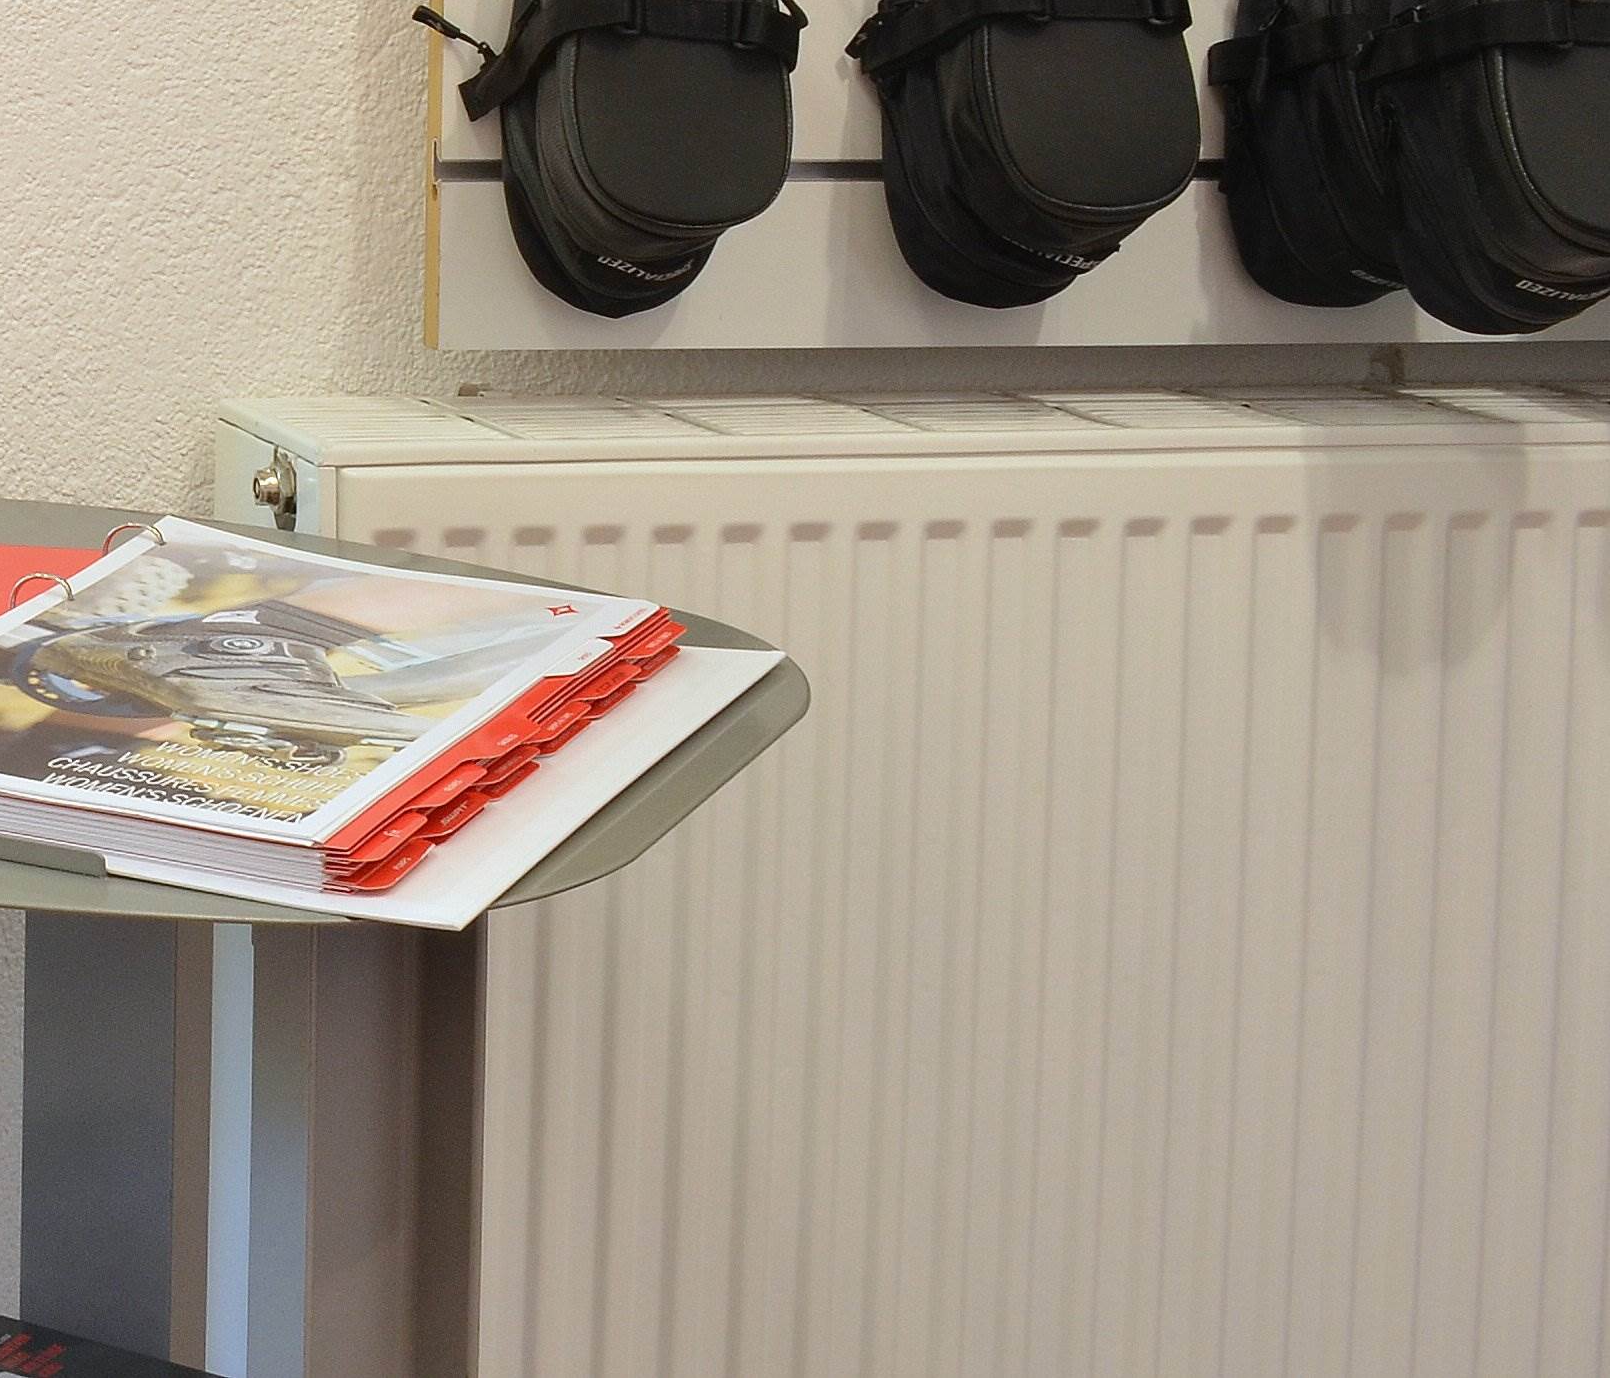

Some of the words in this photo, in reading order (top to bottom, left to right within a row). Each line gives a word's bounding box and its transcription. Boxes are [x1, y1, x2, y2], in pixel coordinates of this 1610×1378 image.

[117, 751, 240, 781] WOMEN'S
[156, 741, 277, 769] WOMEN'S
[42, 772, 166, 803] WOMEN'S
[166, 792, 307, 825] SCHOENEN
[47, 756, 215, 794] CHAUSSURES
[216, 785, 326, 810] FEMMES
